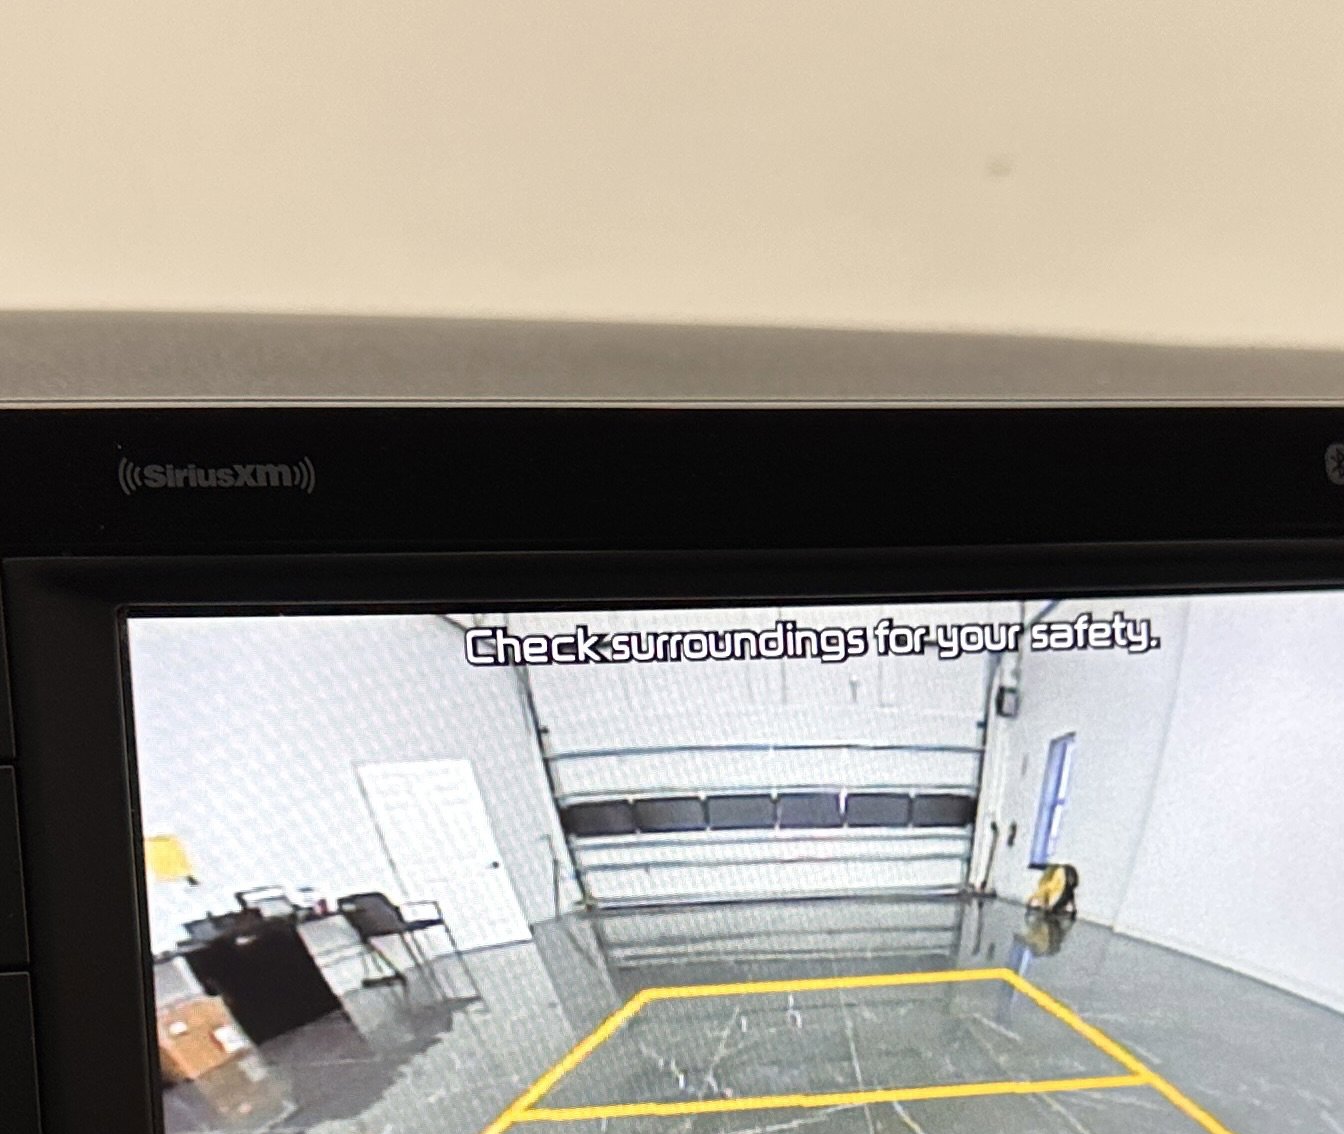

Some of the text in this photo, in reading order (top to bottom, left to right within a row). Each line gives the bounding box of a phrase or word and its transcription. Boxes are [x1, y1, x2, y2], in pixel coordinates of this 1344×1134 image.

[464, 612, 1161, 666] Check surroundings for your safety.
